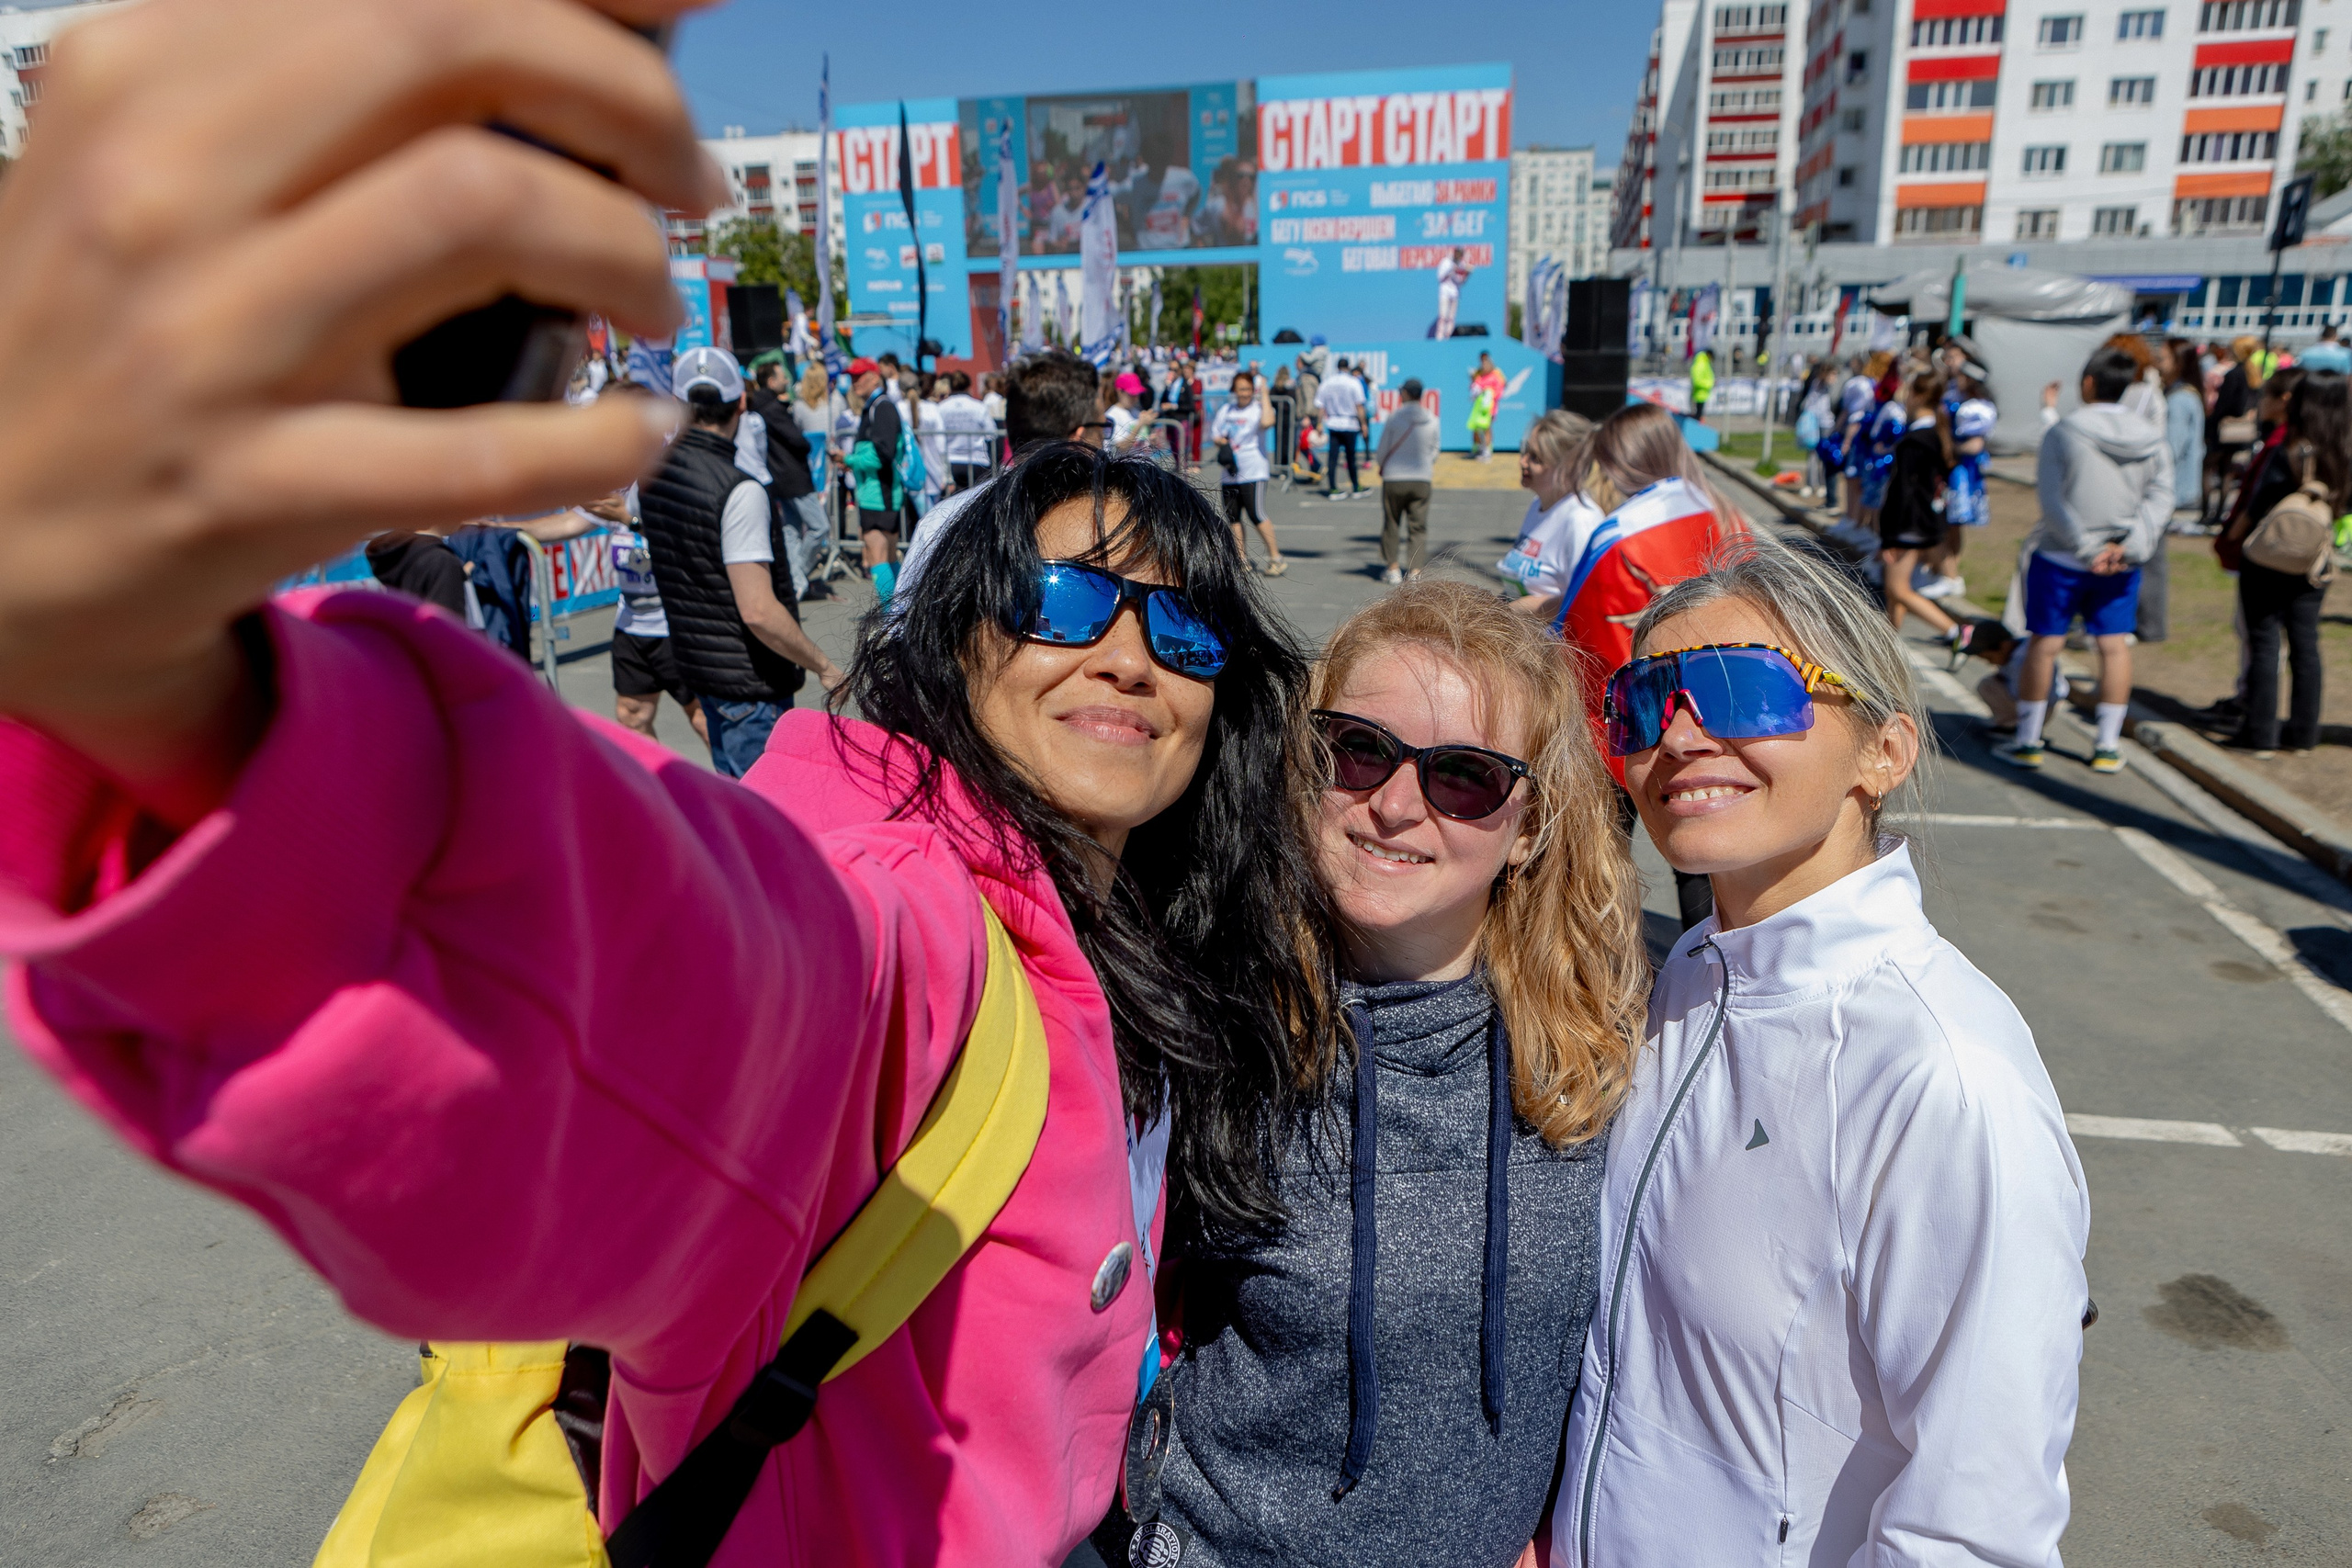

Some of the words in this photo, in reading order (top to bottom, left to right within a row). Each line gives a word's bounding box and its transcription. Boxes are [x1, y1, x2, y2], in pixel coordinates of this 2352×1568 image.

[843, 122, 953, 195] СТАРТ
[1262, 96, 1379, 172] СТАРТ
[1383, 88, 1507, 167] СТАРТ
[1134, 1525, 1178, 1560] DECLARATION
